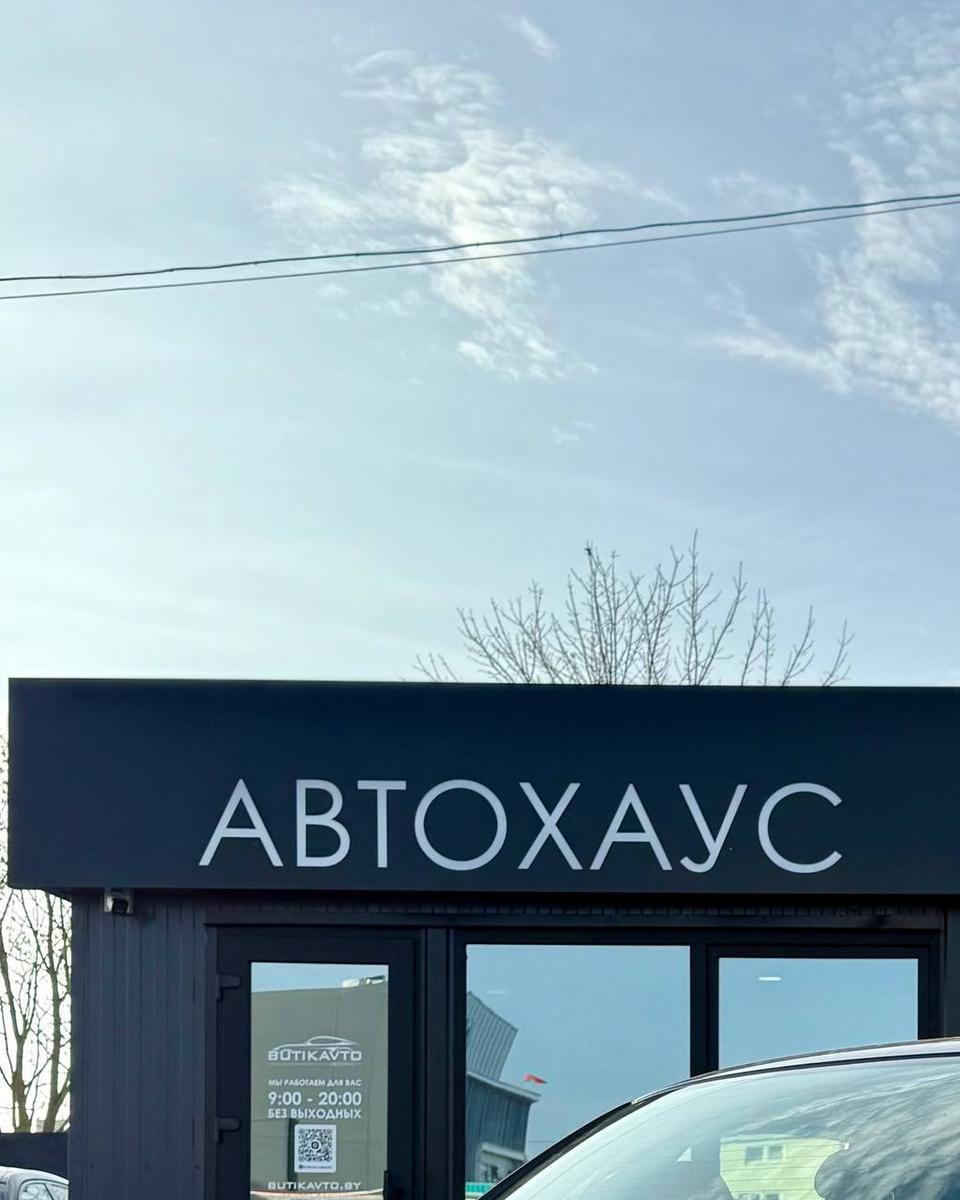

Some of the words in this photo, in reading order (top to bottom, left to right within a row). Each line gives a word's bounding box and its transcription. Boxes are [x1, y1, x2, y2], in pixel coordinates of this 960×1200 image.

[199, 779, 842, 873] АВТОХАУС
[267, 1050, 362, 1061] BUTIKAVTO
[268, 1091, 302, 1106] 9:00
[318, 1091, 362, 1106] 20:00
[268, 1108, 288, 1119] БЕЗ
[290, 1108, 362, 1120] ВЫХОДНЫХ
[267, 1181, 362, 1190] BUTIKAVTO.BY
